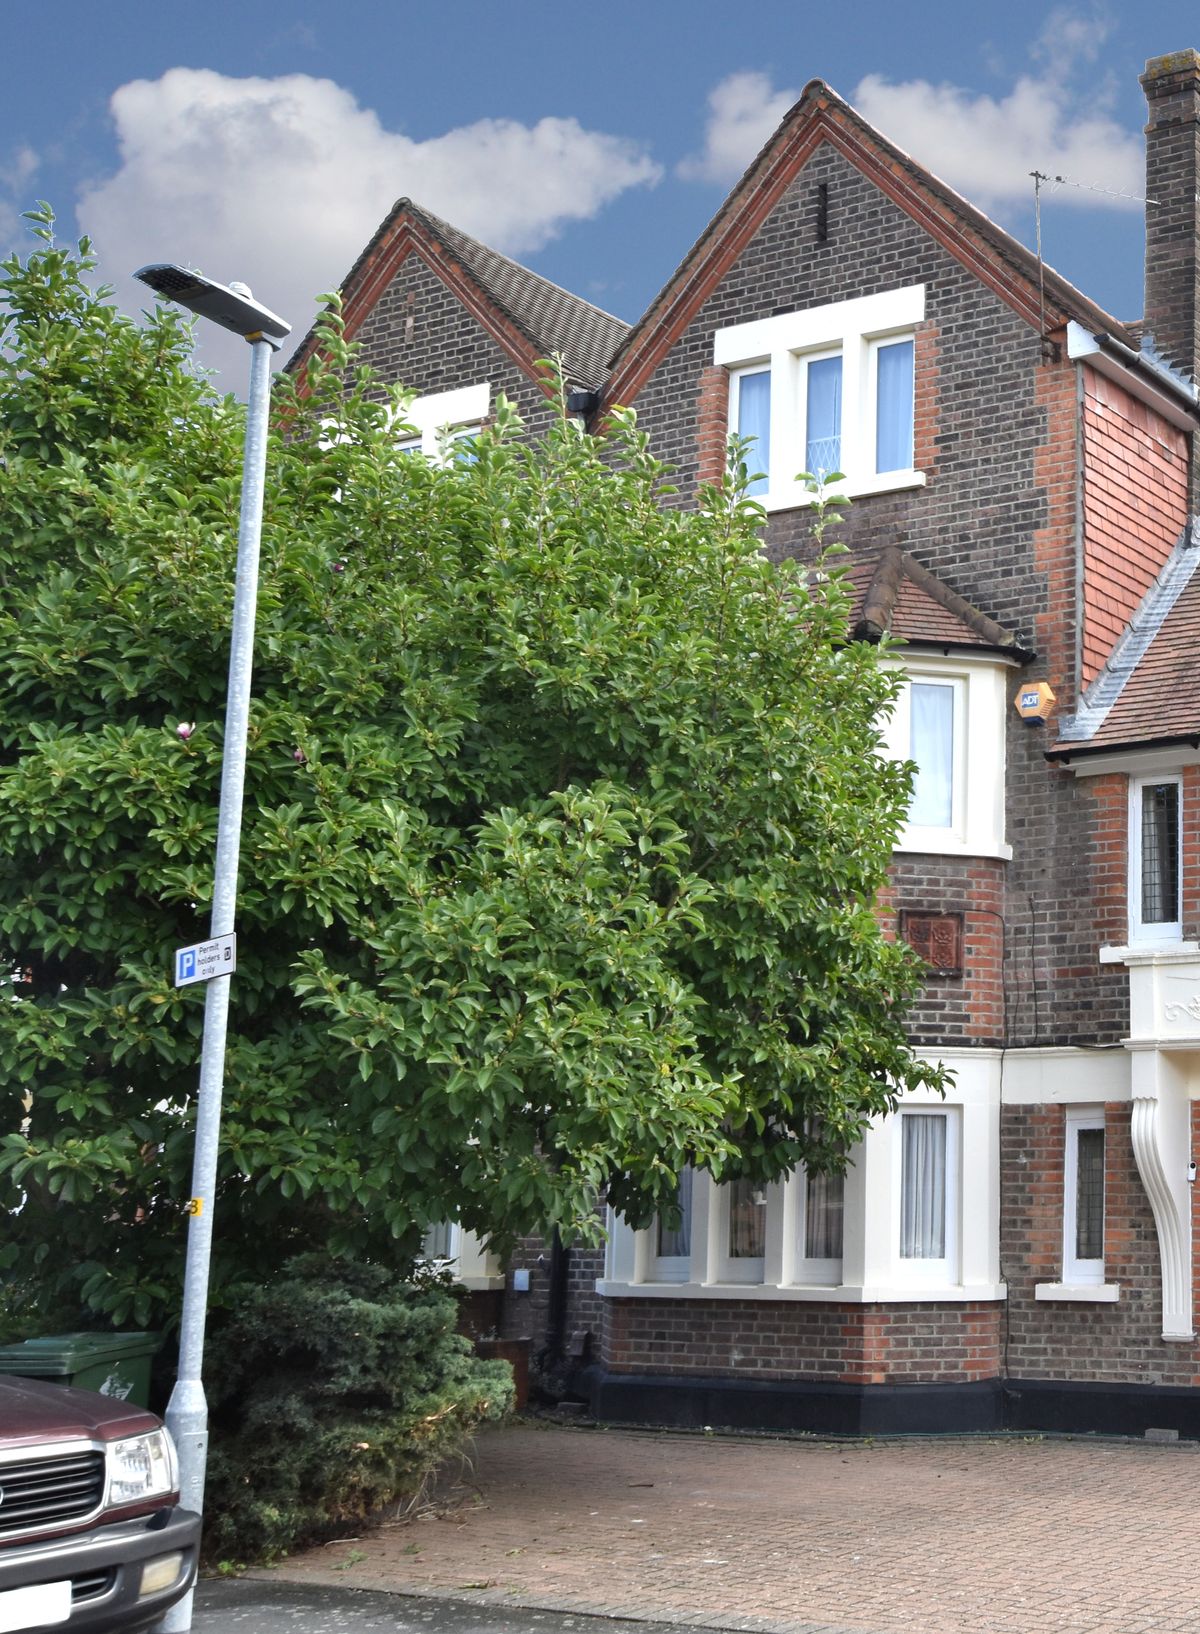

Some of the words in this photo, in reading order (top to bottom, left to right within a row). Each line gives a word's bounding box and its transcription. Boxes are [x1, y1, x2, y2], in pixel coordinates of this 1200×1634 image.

[1022, 695, 1039, 705] ADT
[199, 943, 219, 954] Permit
[183, 953, 193, 977] P
[197, 954, 220, 966] holders
